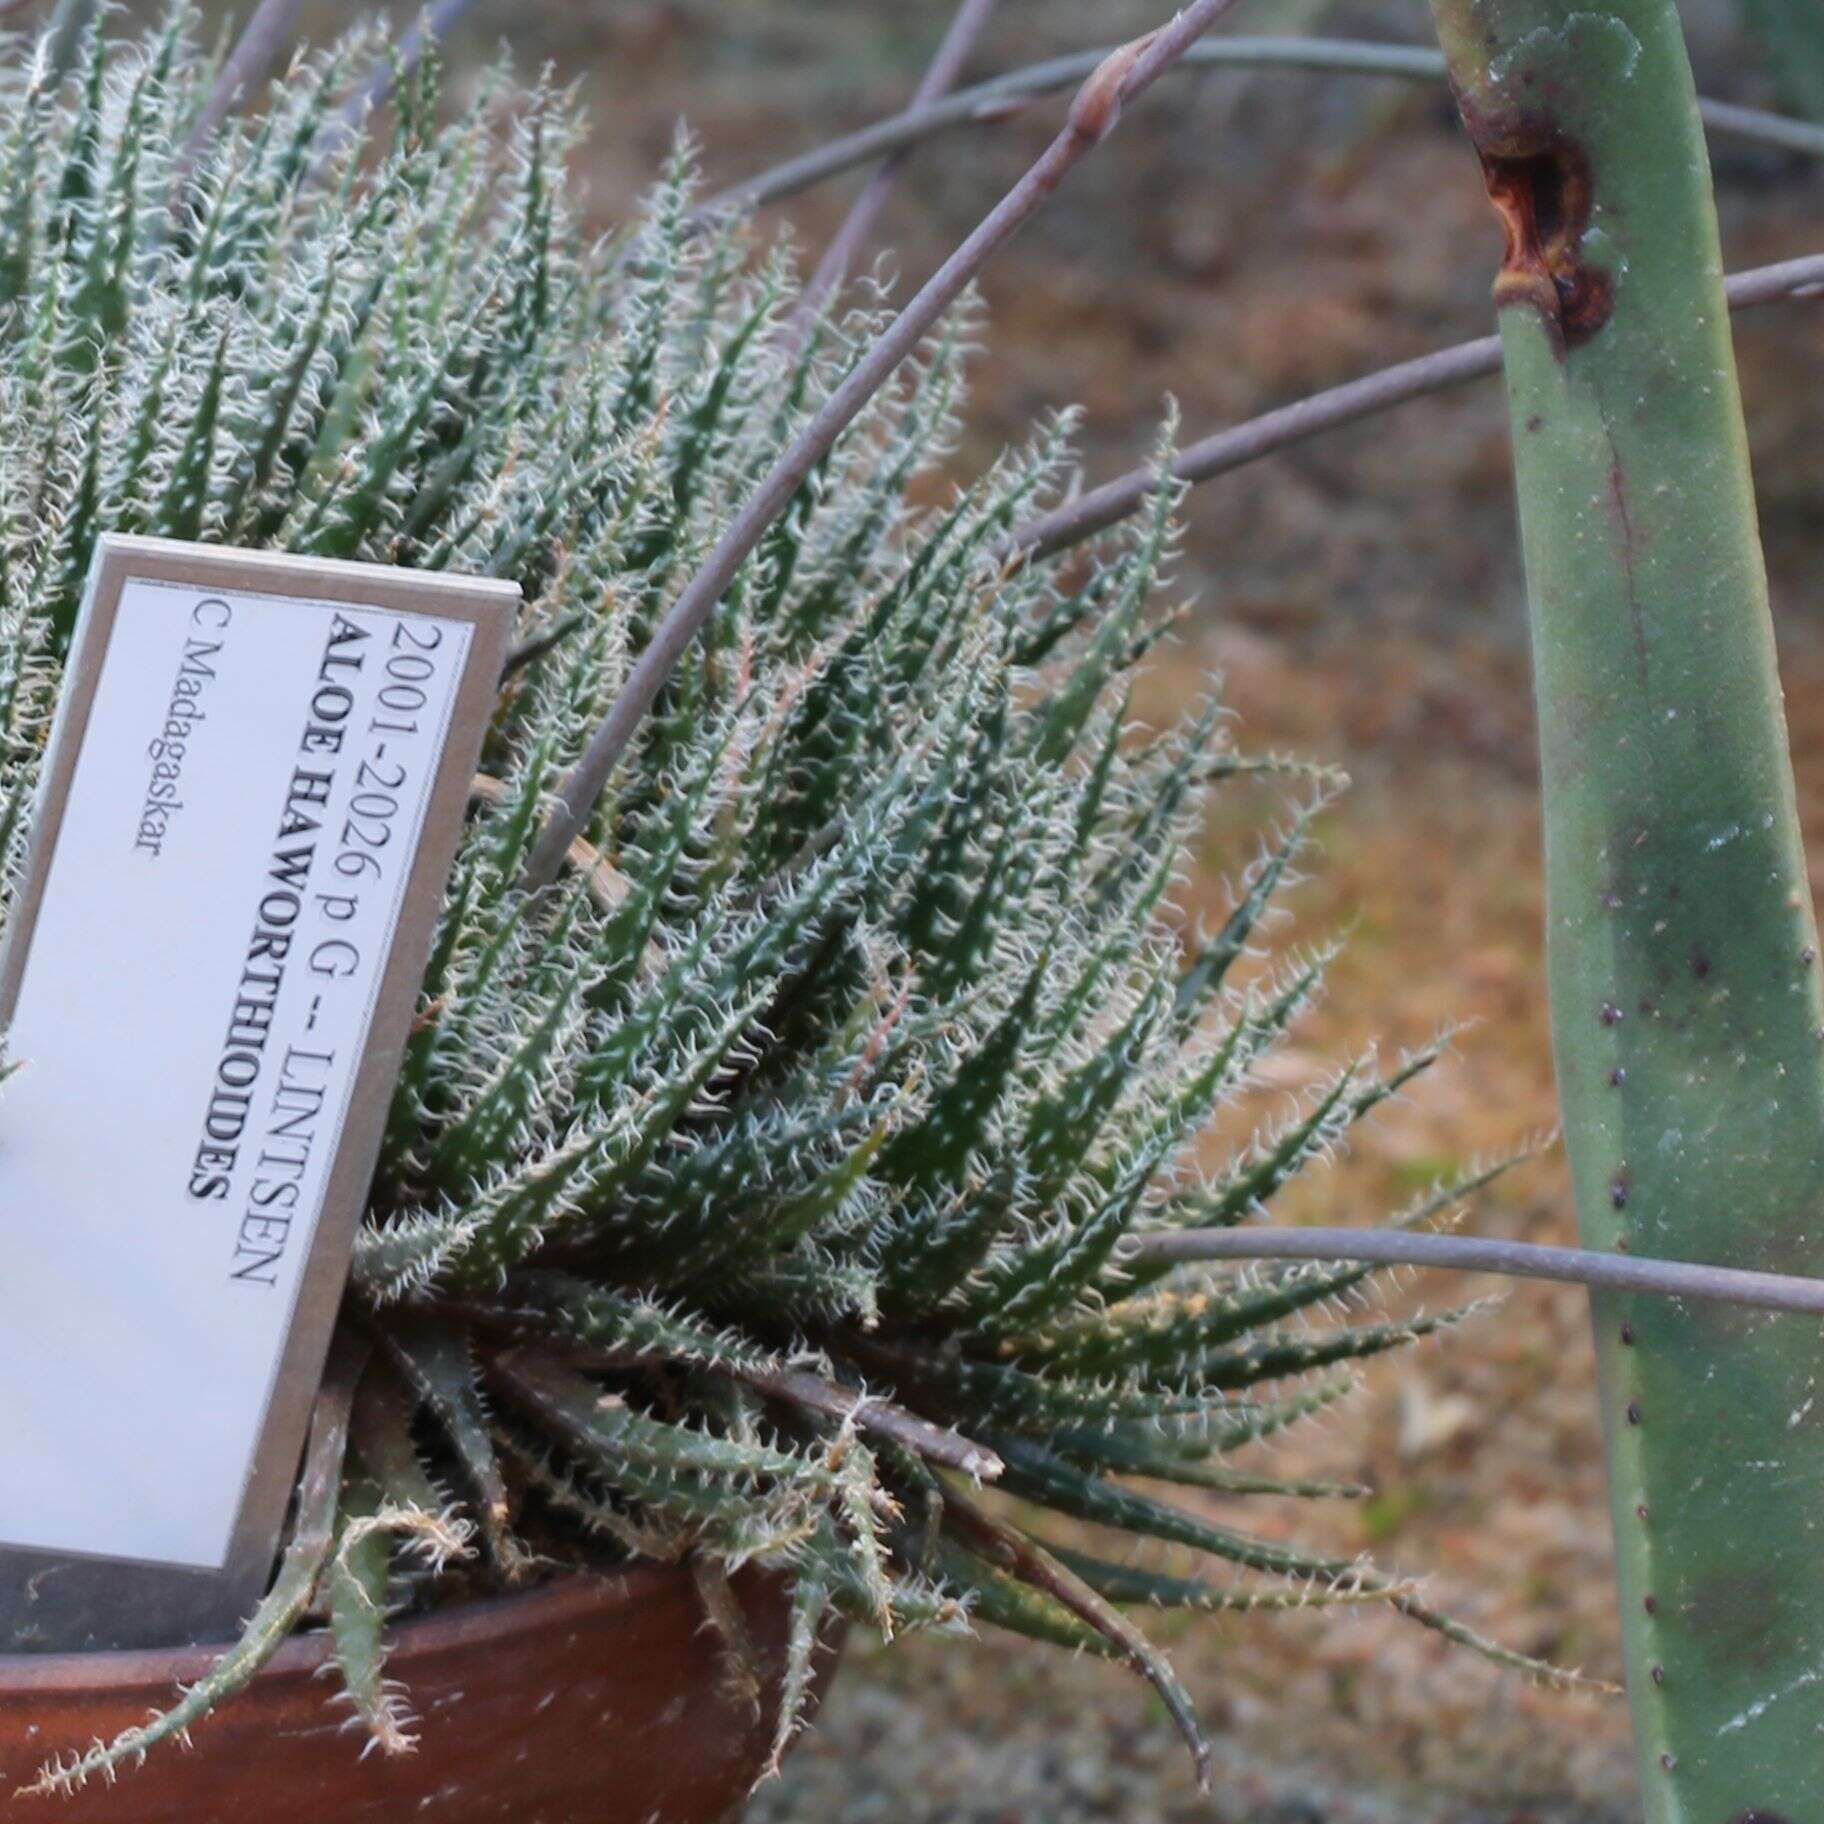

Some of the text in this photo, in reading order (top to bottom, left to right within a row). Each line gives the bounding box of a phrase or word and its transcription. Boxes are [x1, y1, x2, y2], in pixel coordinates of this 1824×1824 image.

[135, 597, 232, 856] C Madagaskar
[333, 622, 442, 880] 2001-2026
[188, 612, 372, 1201] ALOE HAWORTHIOIDES
[309, 939, 360, 979] G
[315, 892, 359, 921] p
[230, 1044, 335, 1287] LINTSEN
